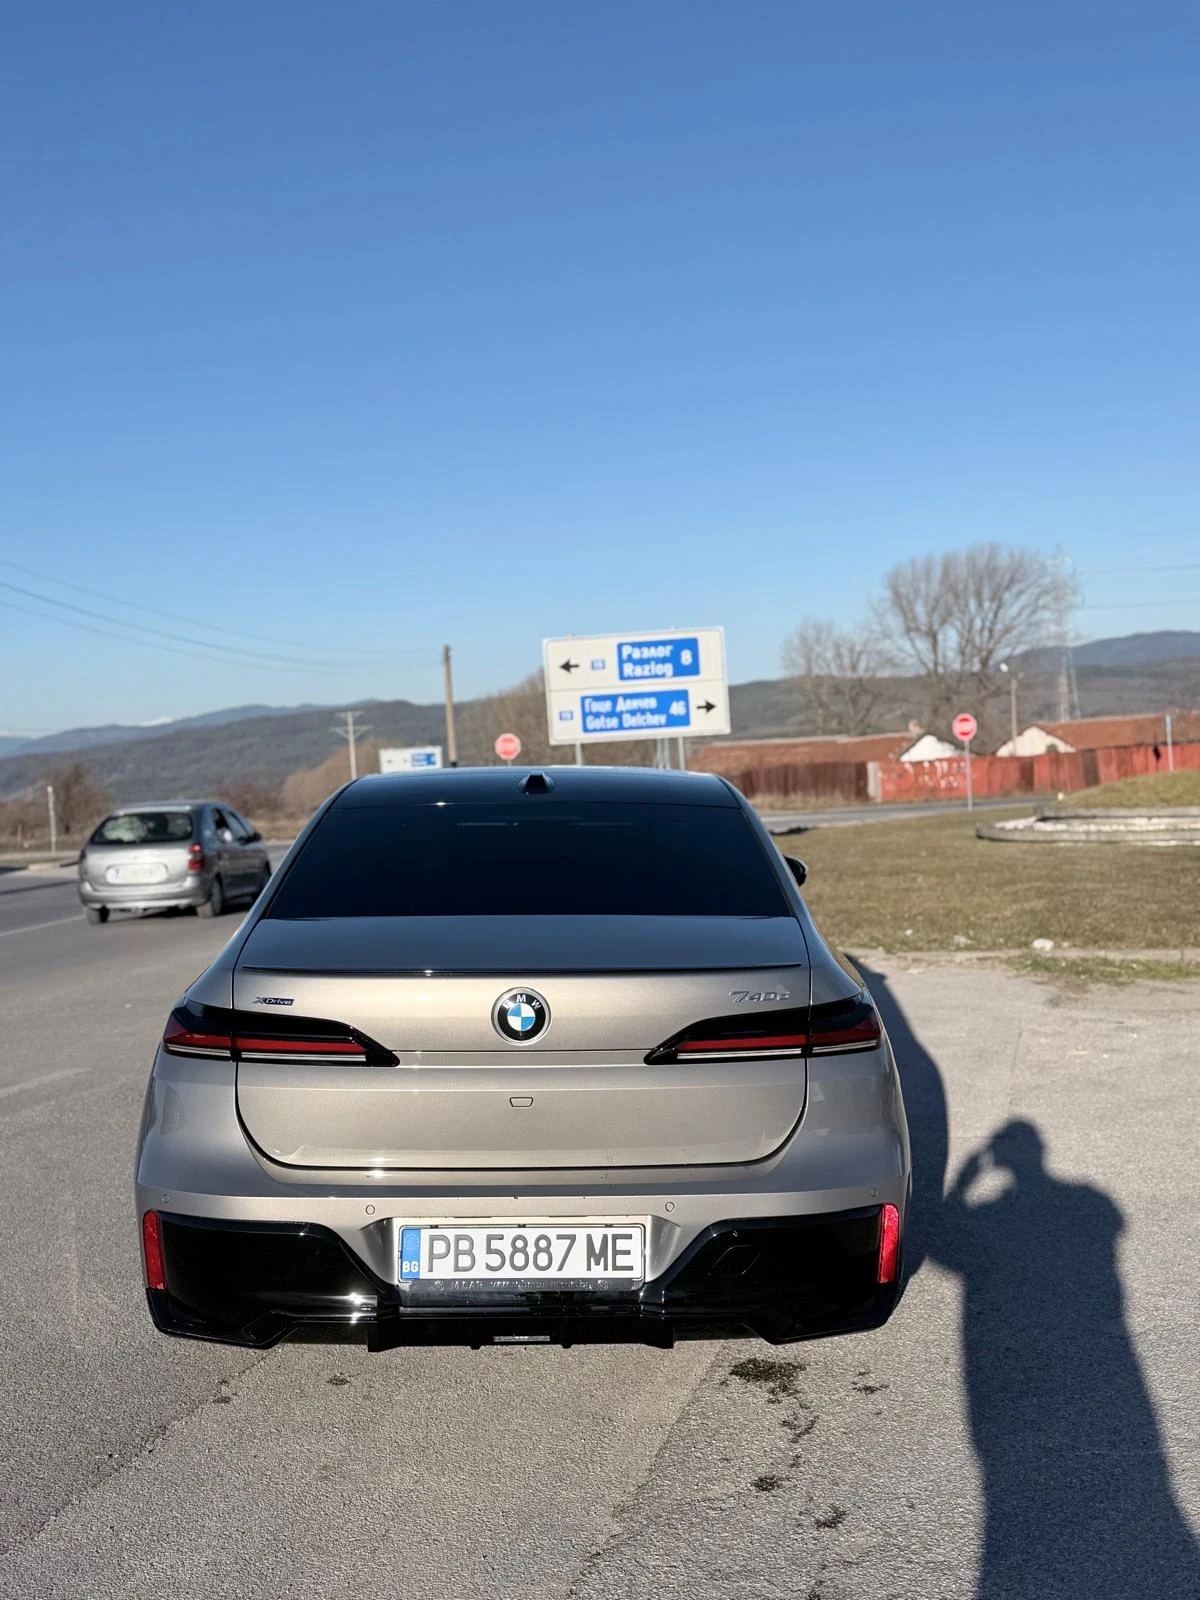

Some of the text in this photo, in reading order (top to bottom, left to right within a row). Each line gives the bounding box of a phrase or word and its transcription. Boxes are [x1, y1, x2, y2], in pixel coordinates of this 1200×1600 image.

[622, 645, 674, 660] Разлог
[681, 649, 693, 666] 8
[623, 661, 674, 678] Razlog
[586, 712, 667, 730] Gotse Delchev
[502, 994, 542, 1010] BMW
[428, 1233, 634, 1273] PB 5887 ME
[402, 1261, 419, 1273] BG
